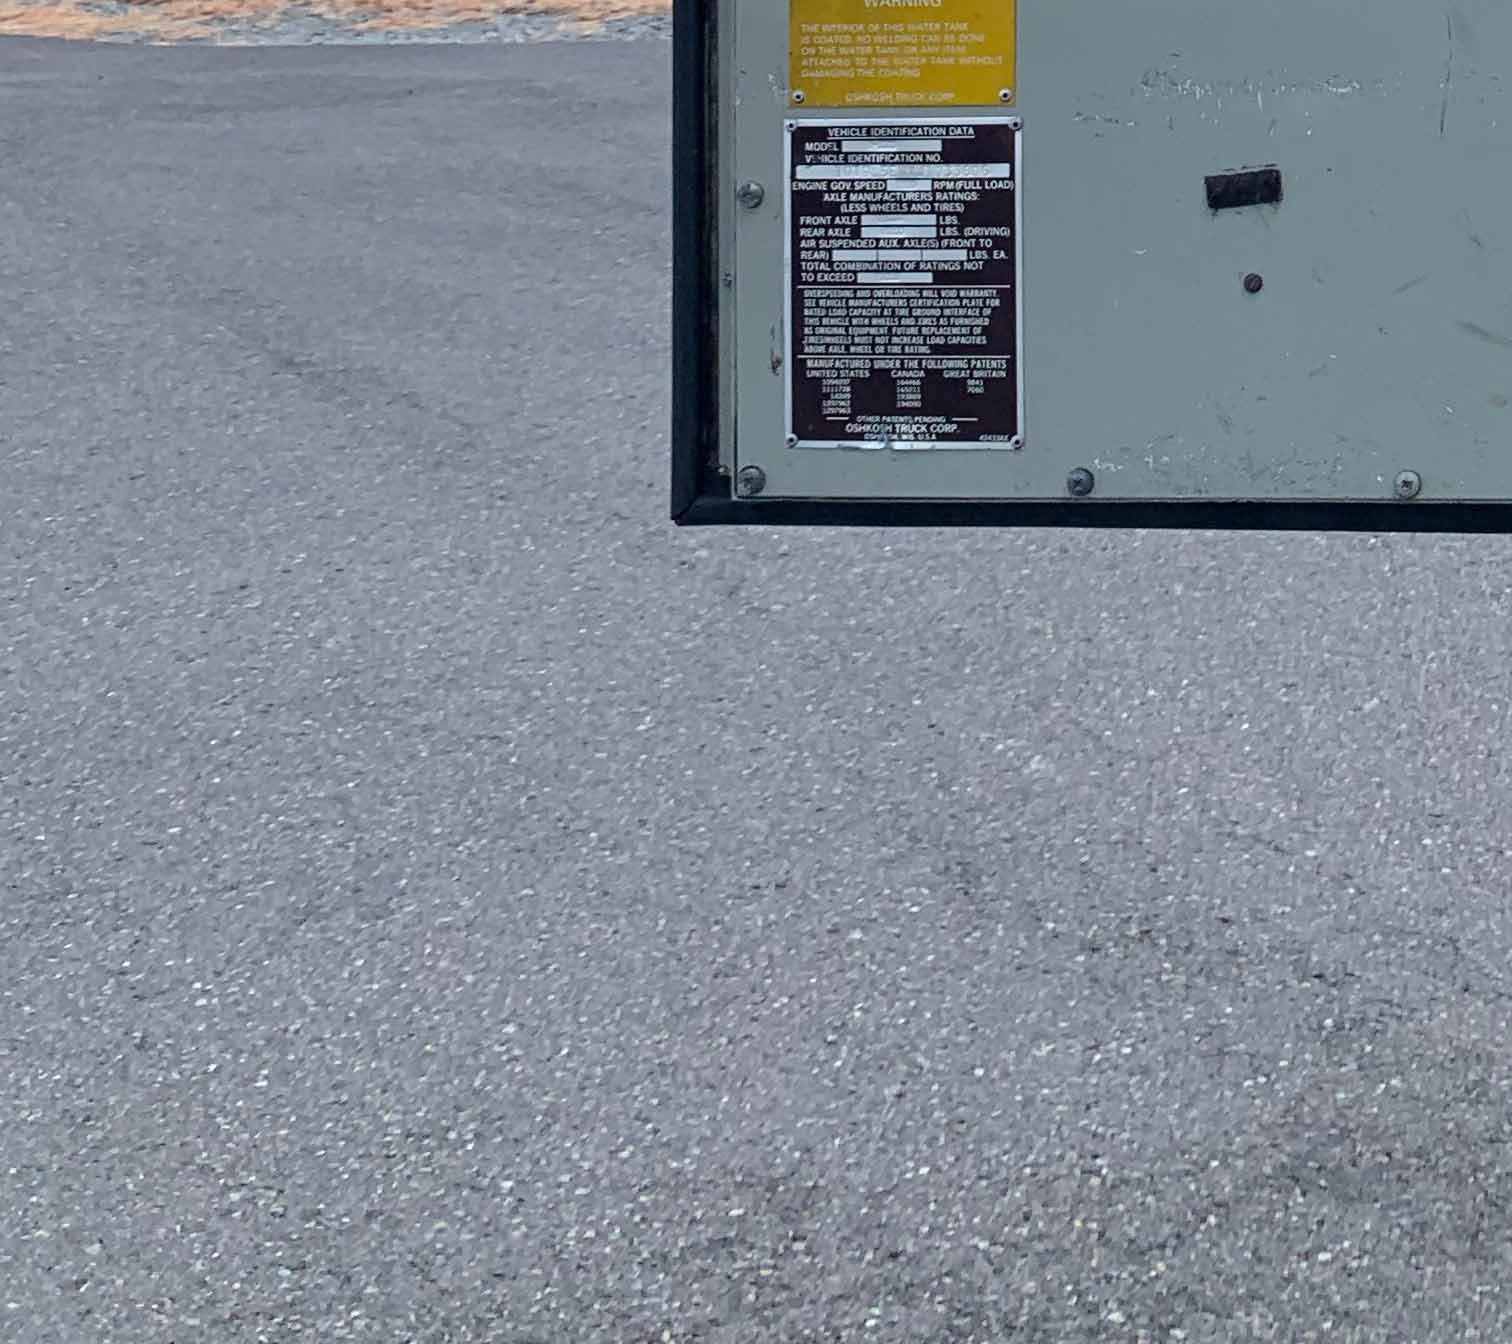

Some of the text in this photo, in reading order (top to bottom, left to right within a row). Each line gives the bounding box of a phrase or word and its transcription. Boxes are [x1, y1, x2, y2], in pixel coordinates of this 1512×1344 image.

[827, 126, 975, 137] VEHICLE IDENTIFICATION DATA
[805, 142, 839, 151] MODEL
[847, 153, 923, 163] IDENTIFICATION
[925, 153, 944, 162] NO.
[792, 181, 829, 191] ENGINE
[854, 181, 886, 190] SPEED
[956, 180, 982, 190] (FULL
[985, 180, 1013, 190] LOAD)
[823, 192, 847, 201] AXLE
[849, 192, 933, 201] MANUFACTURERS
[840, 202, 965, 212] (LESS WHEELS AND TIRES)
[800, 215, 858, 225] FRONT AXLE
[940, 215, 960, 225] LBS.
[800, 227, 852, 237] REAR AXLE
[940, 226, 1010, 237] LBS. (DRIVING)
[800, 239, 816, 248] AIR
[818, 239, 876, 248] SUSPENDED
[903, 238, 939, 247] AXLE(S)
[941, 238, 976, 247] (FRONT
[978, 237, 993, 247] TO
[800, 250, 830, 260] REAR)
[969, 250, 1008, 259] LBS. EA.
[800, 261, 984, 271] TOTAL COMBINATION OF RATINGS NOT
[801, 272, 855, 282] TO EXCEED
[806, 359, 1007, 368] MANUFACTURED UNDER THE FOLLOWING PATENTS
[806, 370, 870, 378] UNITED STATES
[891, 370, 926, 378] CANADA
[943, 370, 1007, 378] GREAT BRITAIN
[845, 423, 960, 433] OSHKOSH TRUCK CORP.
